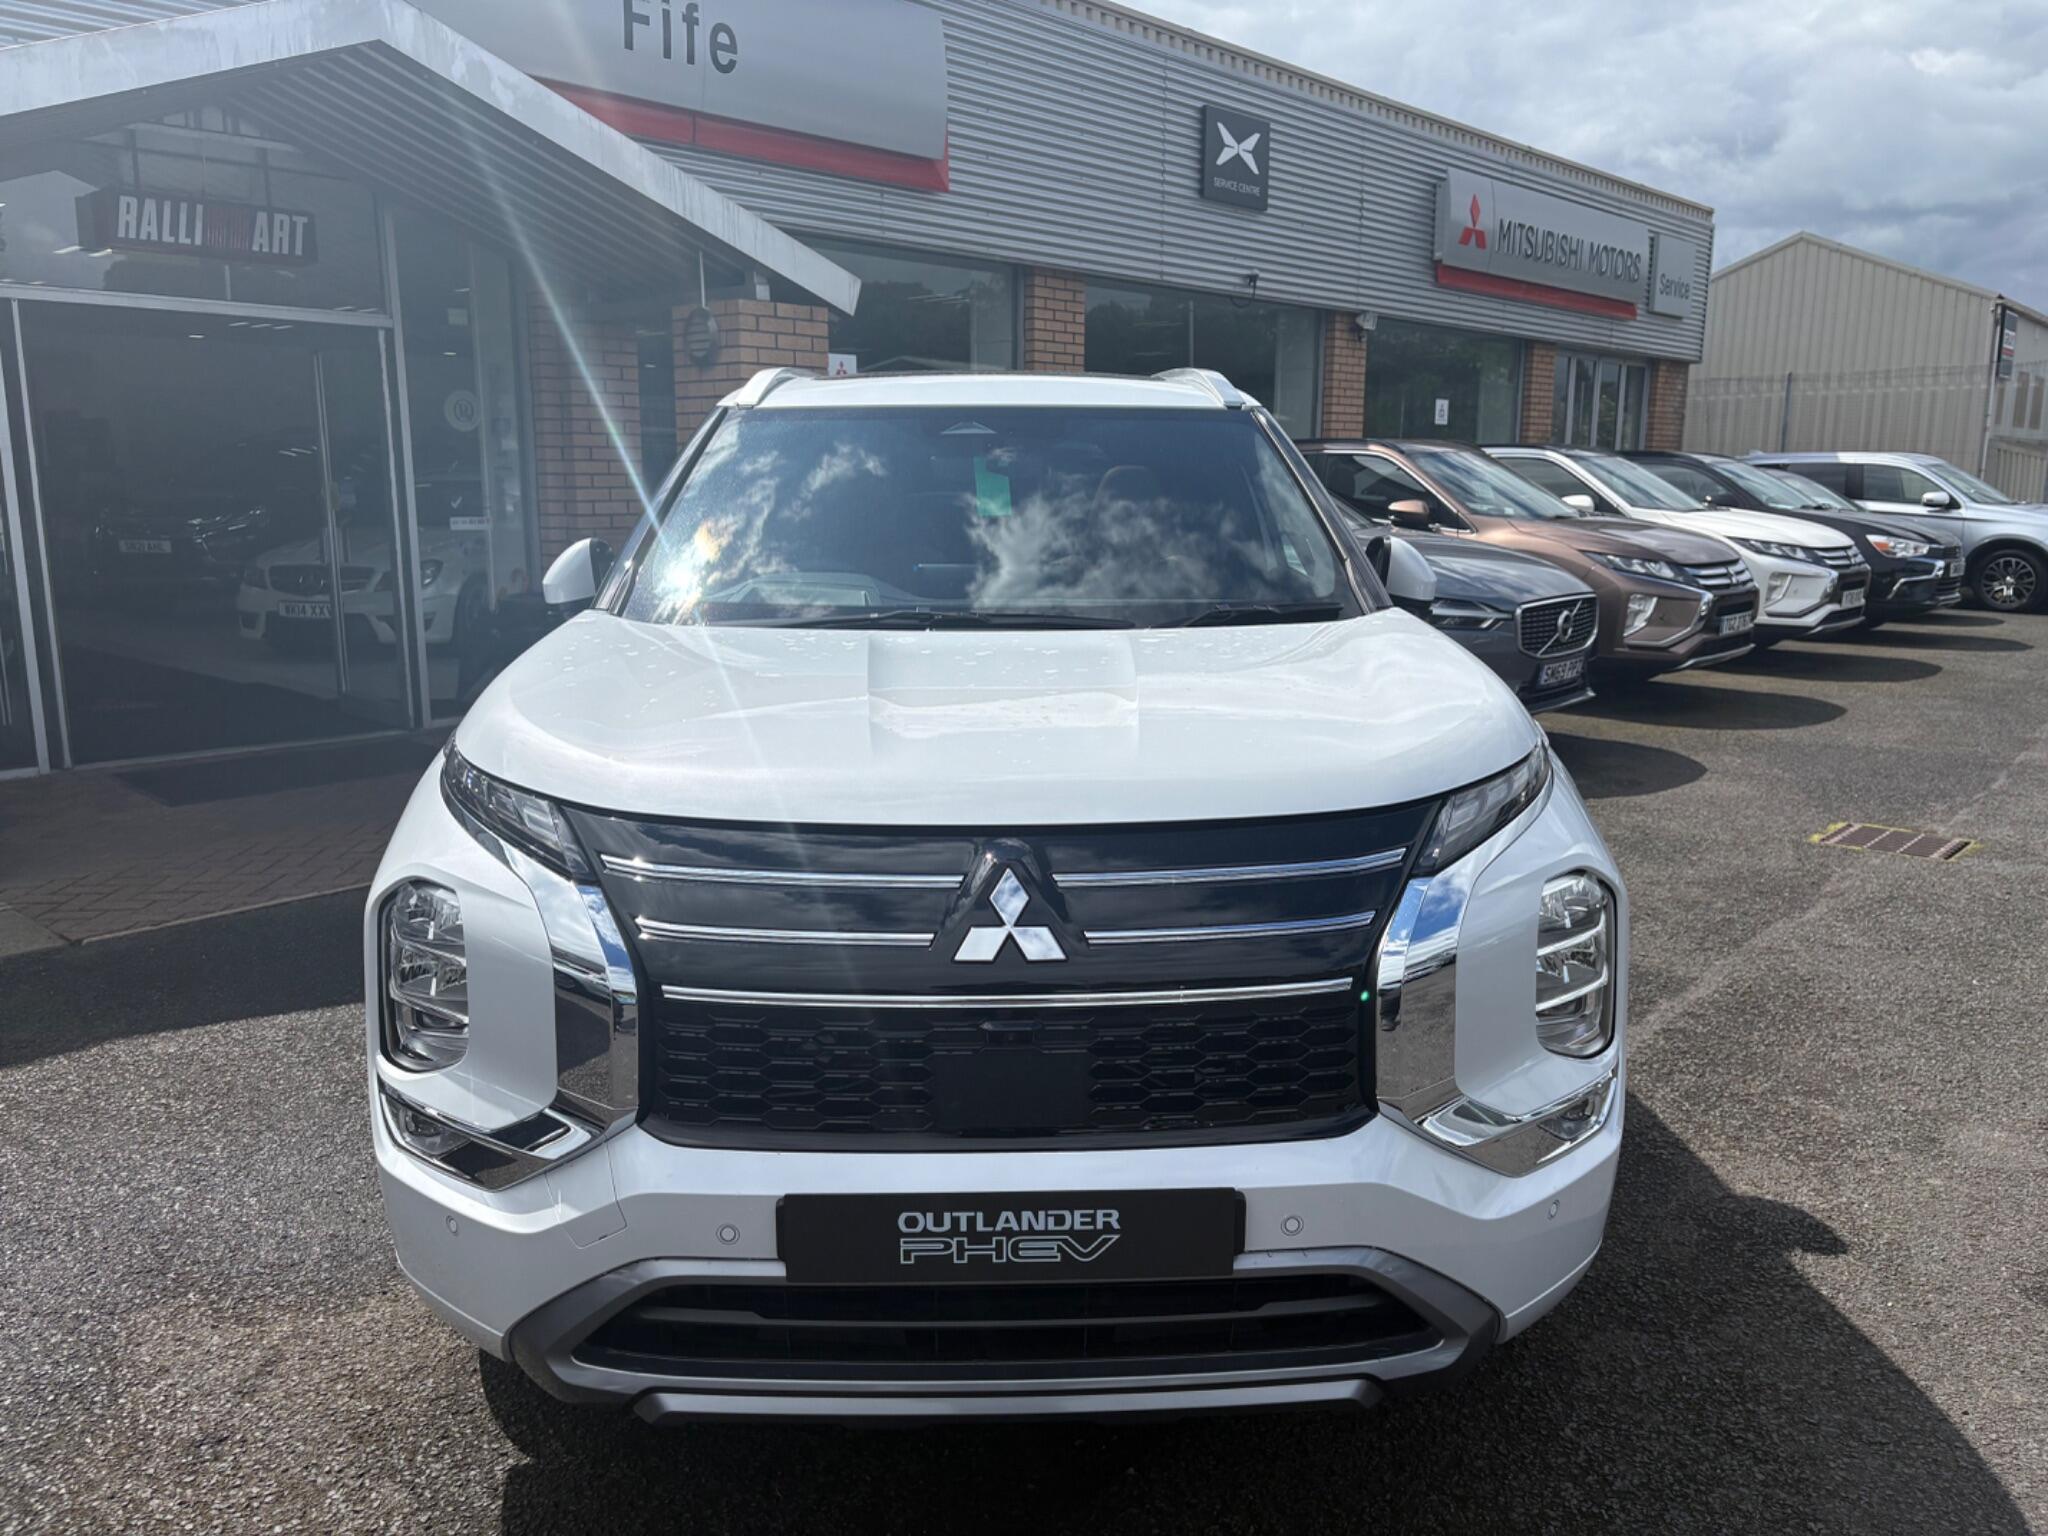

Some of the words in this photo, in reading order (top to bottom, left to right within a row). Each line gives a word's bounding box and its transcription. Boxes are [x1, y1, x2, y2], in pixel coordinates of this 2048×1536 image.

[623, 0, 738, 74] Fife
[1497, 217, 1583, 271] MITSUBISHI
[1588, 240, 1642, 283] MOTORS
[1659, 273, 1690, 300] Service
[898, 1209, 1121, 1233] OUTLANDER
[900, 1234, 1121, 1264] PHEV
